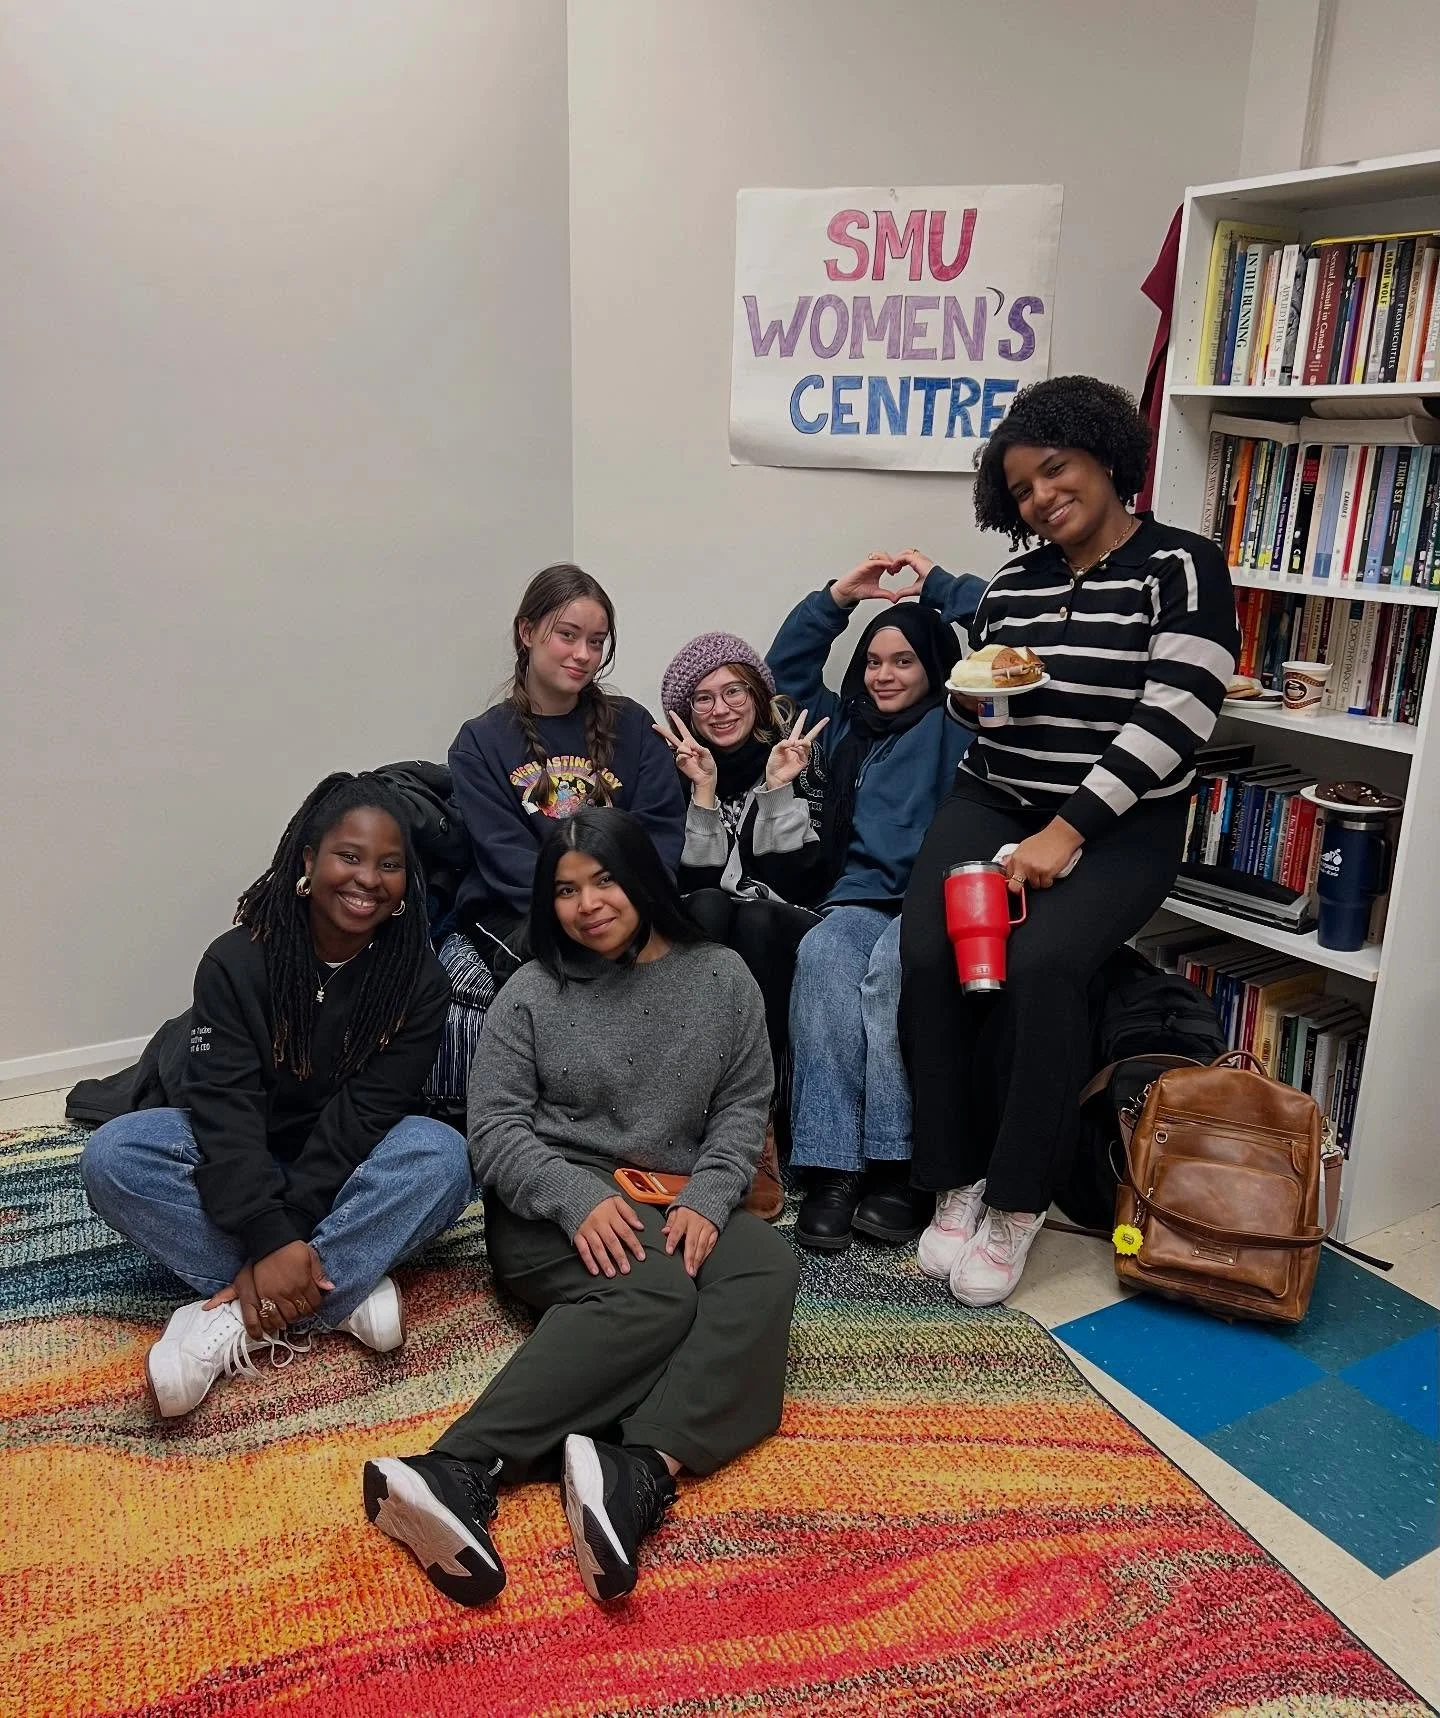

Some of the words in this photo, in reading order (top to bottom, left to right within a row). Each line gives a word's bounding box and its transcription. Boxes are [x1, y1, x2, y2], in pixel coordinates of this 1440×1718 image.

[823, 208, 978, 281] SMU
[1248, 252, 1258, 266] IN
[1328, 251, 1339, 278] Sexual
[1384, 251, 1394, 278] NAOMI
[1246, 269, 1256, 293] THE
[1323, 281, 1334, 310] Assault
[1380, 282, 1389, 305] WOLF
[1280, 285, 1290, 318] APPLIED
[1322, 312, 1329, 320] in
[743, 287, 1044, 361] WOMEN'S
[1237, 295, 1252, 347] RUNNING
[1275, 319, 1287, 352] ETHICS
[1316, 322, 1328, 353] Canada
[1388, 304, 1404, 369] PROMISCUITIES
[1430, 323, 1439, 351] ATTACK
[790, 375, 1019, 438] CENTRE
[1396, 461, 1407, 487] FIXING
[1392, 489, 1403, 504] SEX
[1345, 621, 1360, 663] DOROTHY
[1342, 664, 1352, 693] PARKER
